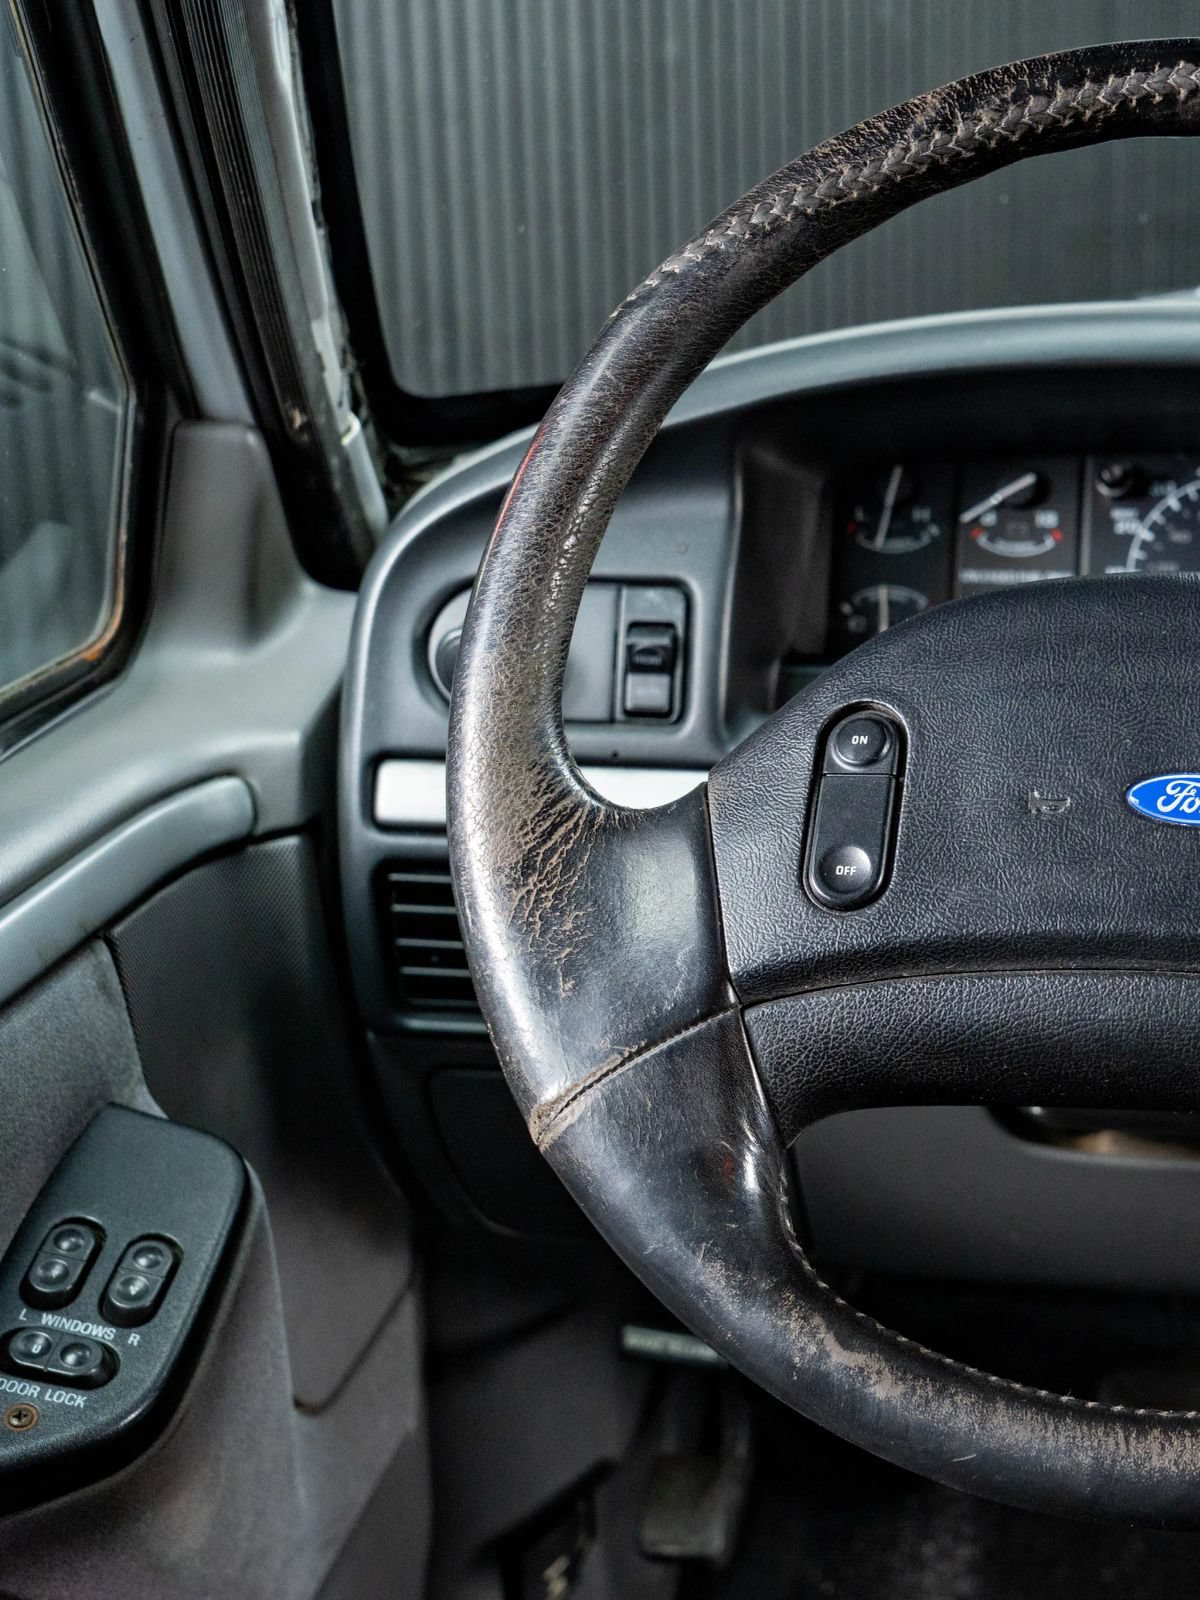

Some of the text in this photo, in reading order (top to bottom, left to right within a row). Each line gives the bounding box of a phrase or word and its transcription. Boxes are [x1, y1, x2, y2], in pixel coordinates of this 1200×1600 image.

[852, 735, 868, 745] ON
[835, 865, 857, 876] OFF
[19, 1308, 140, 1346] L WINDOWS R
[44, 1389, 87, 1409] LOCK
